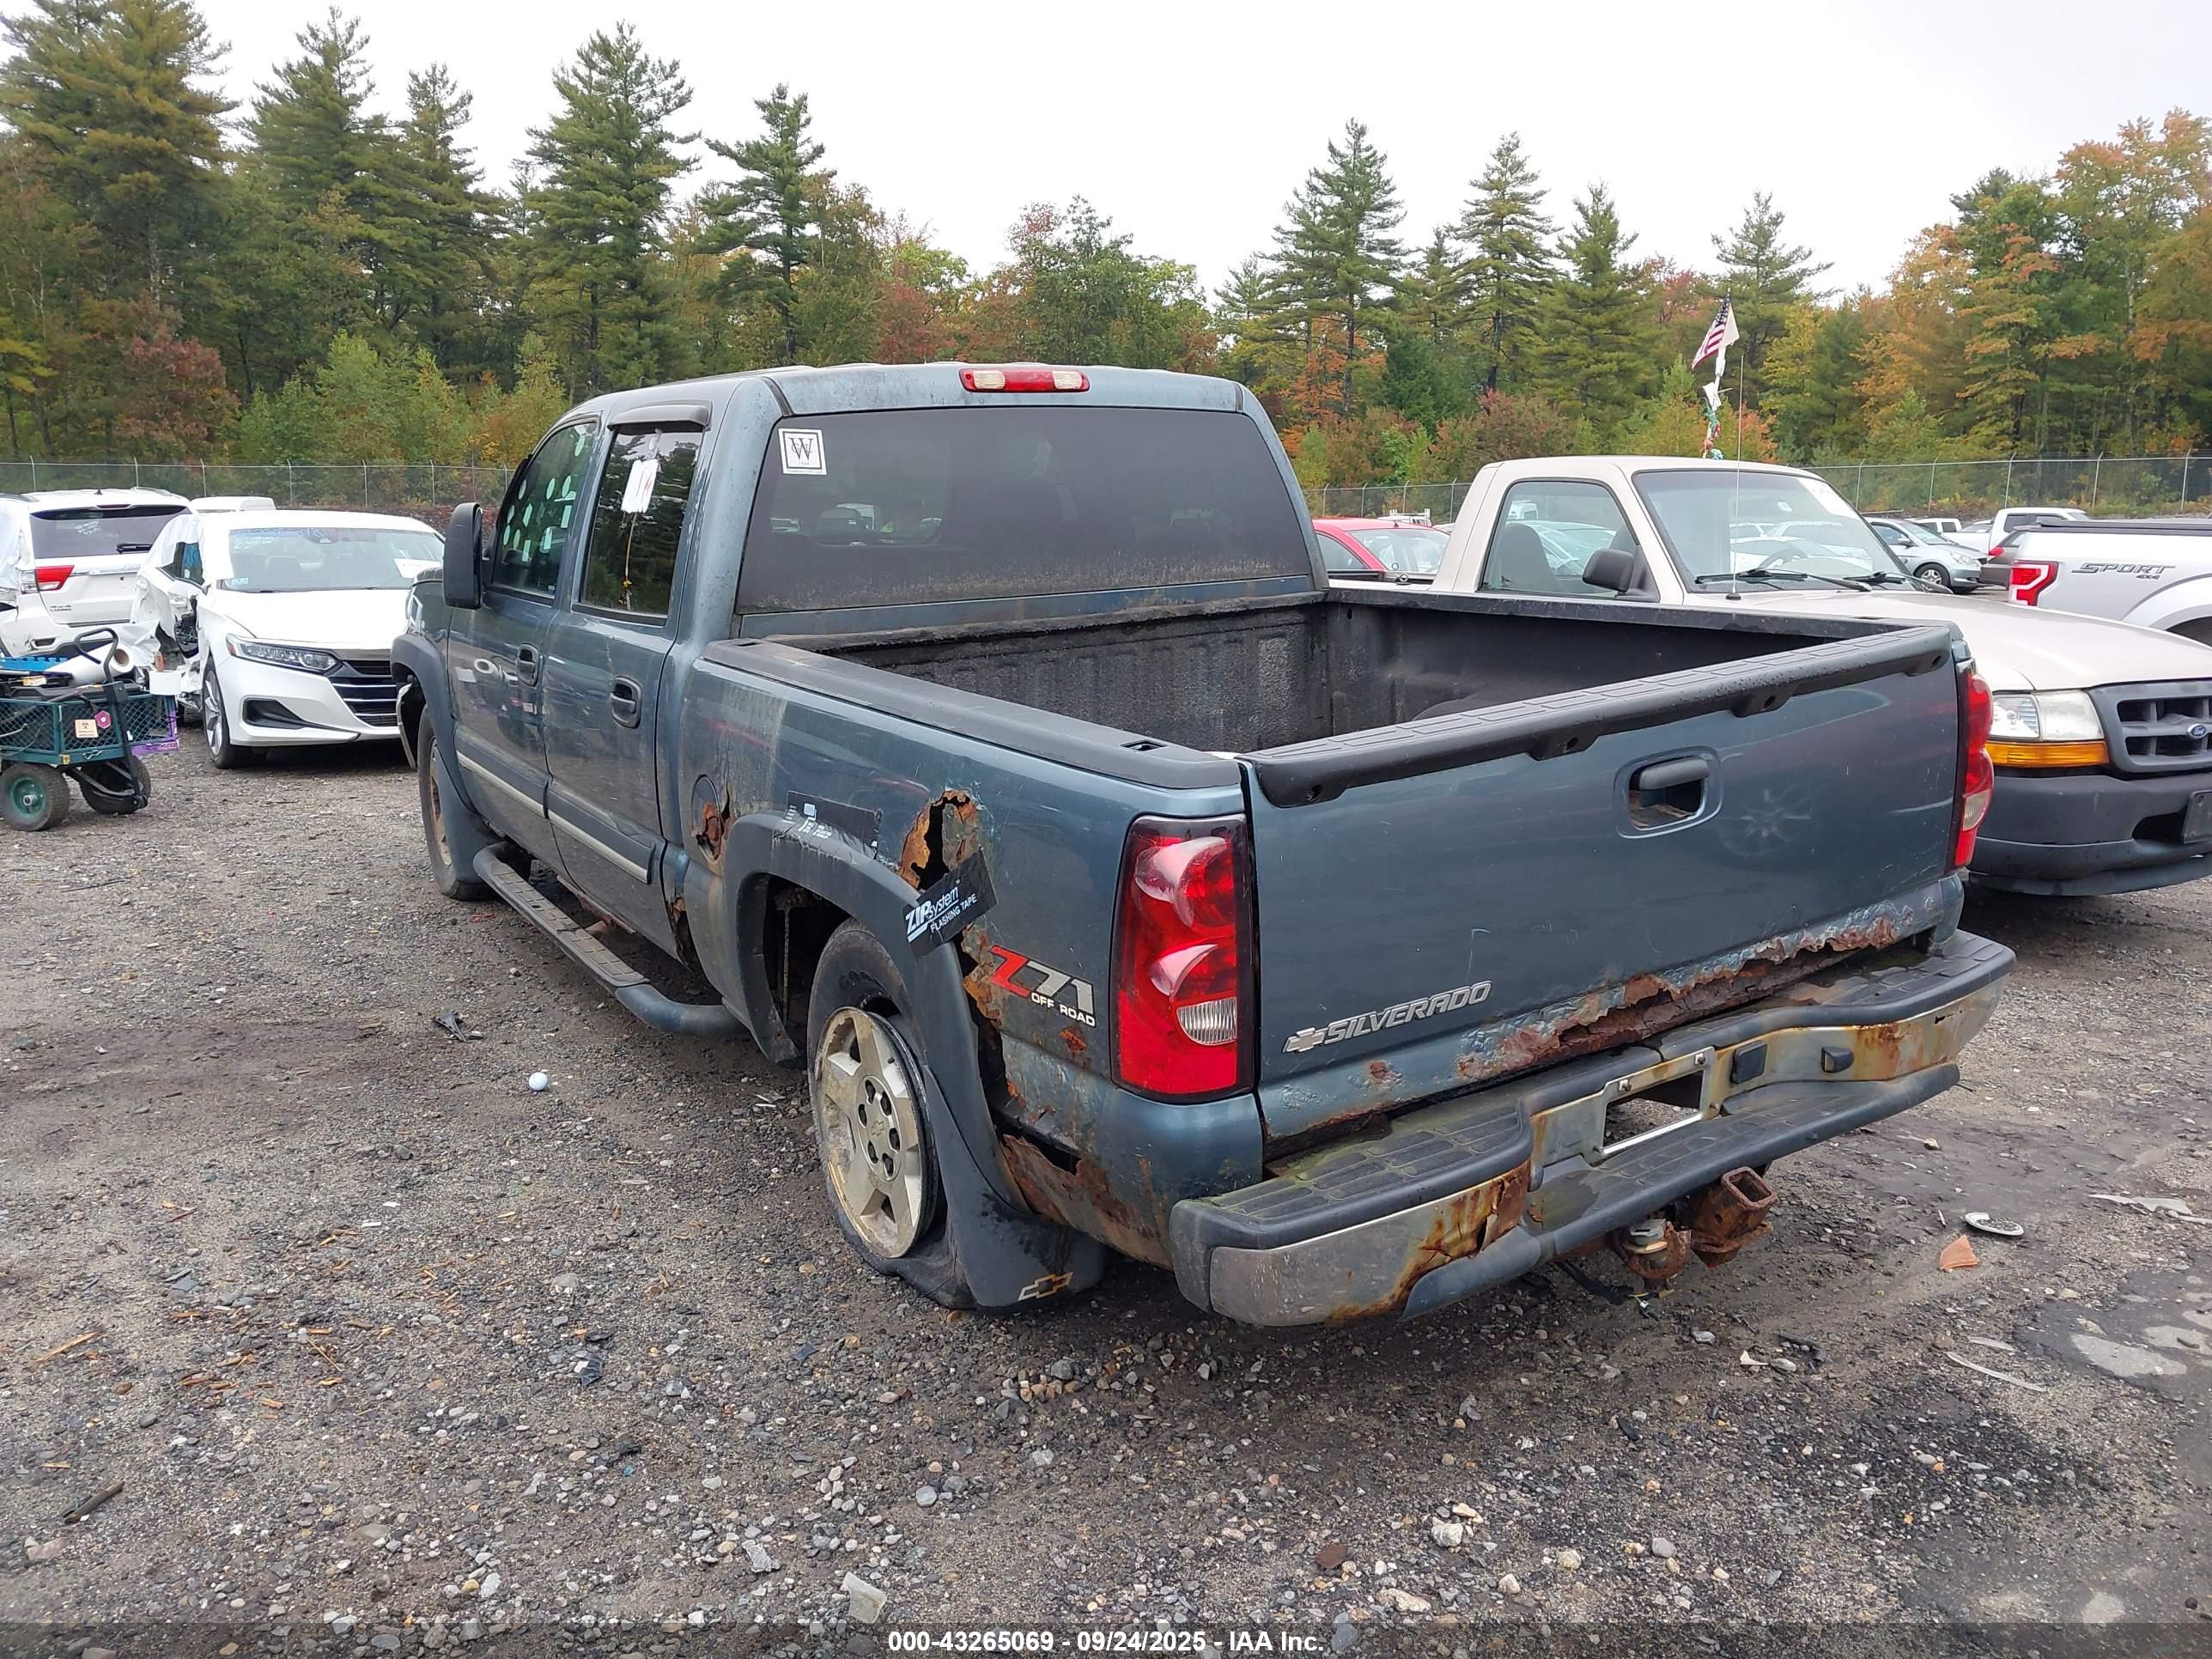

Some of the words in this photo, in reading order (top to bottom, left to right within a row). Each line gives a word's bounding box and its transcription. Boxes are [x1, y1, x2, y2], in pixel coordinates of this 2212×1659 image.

[2071, 562, 2177, 574] SPORT
[930, 905, 961, 933] FLASHING
[960, 893, 977, 911] TAPE
[990, 945, 1095, 1015] Z71
[1031, 992, 1055, 1011] OFF
[1059, 1003, 1096, 1027] ROAD
[1324, 980, 1492, 1045] SILVERADO
